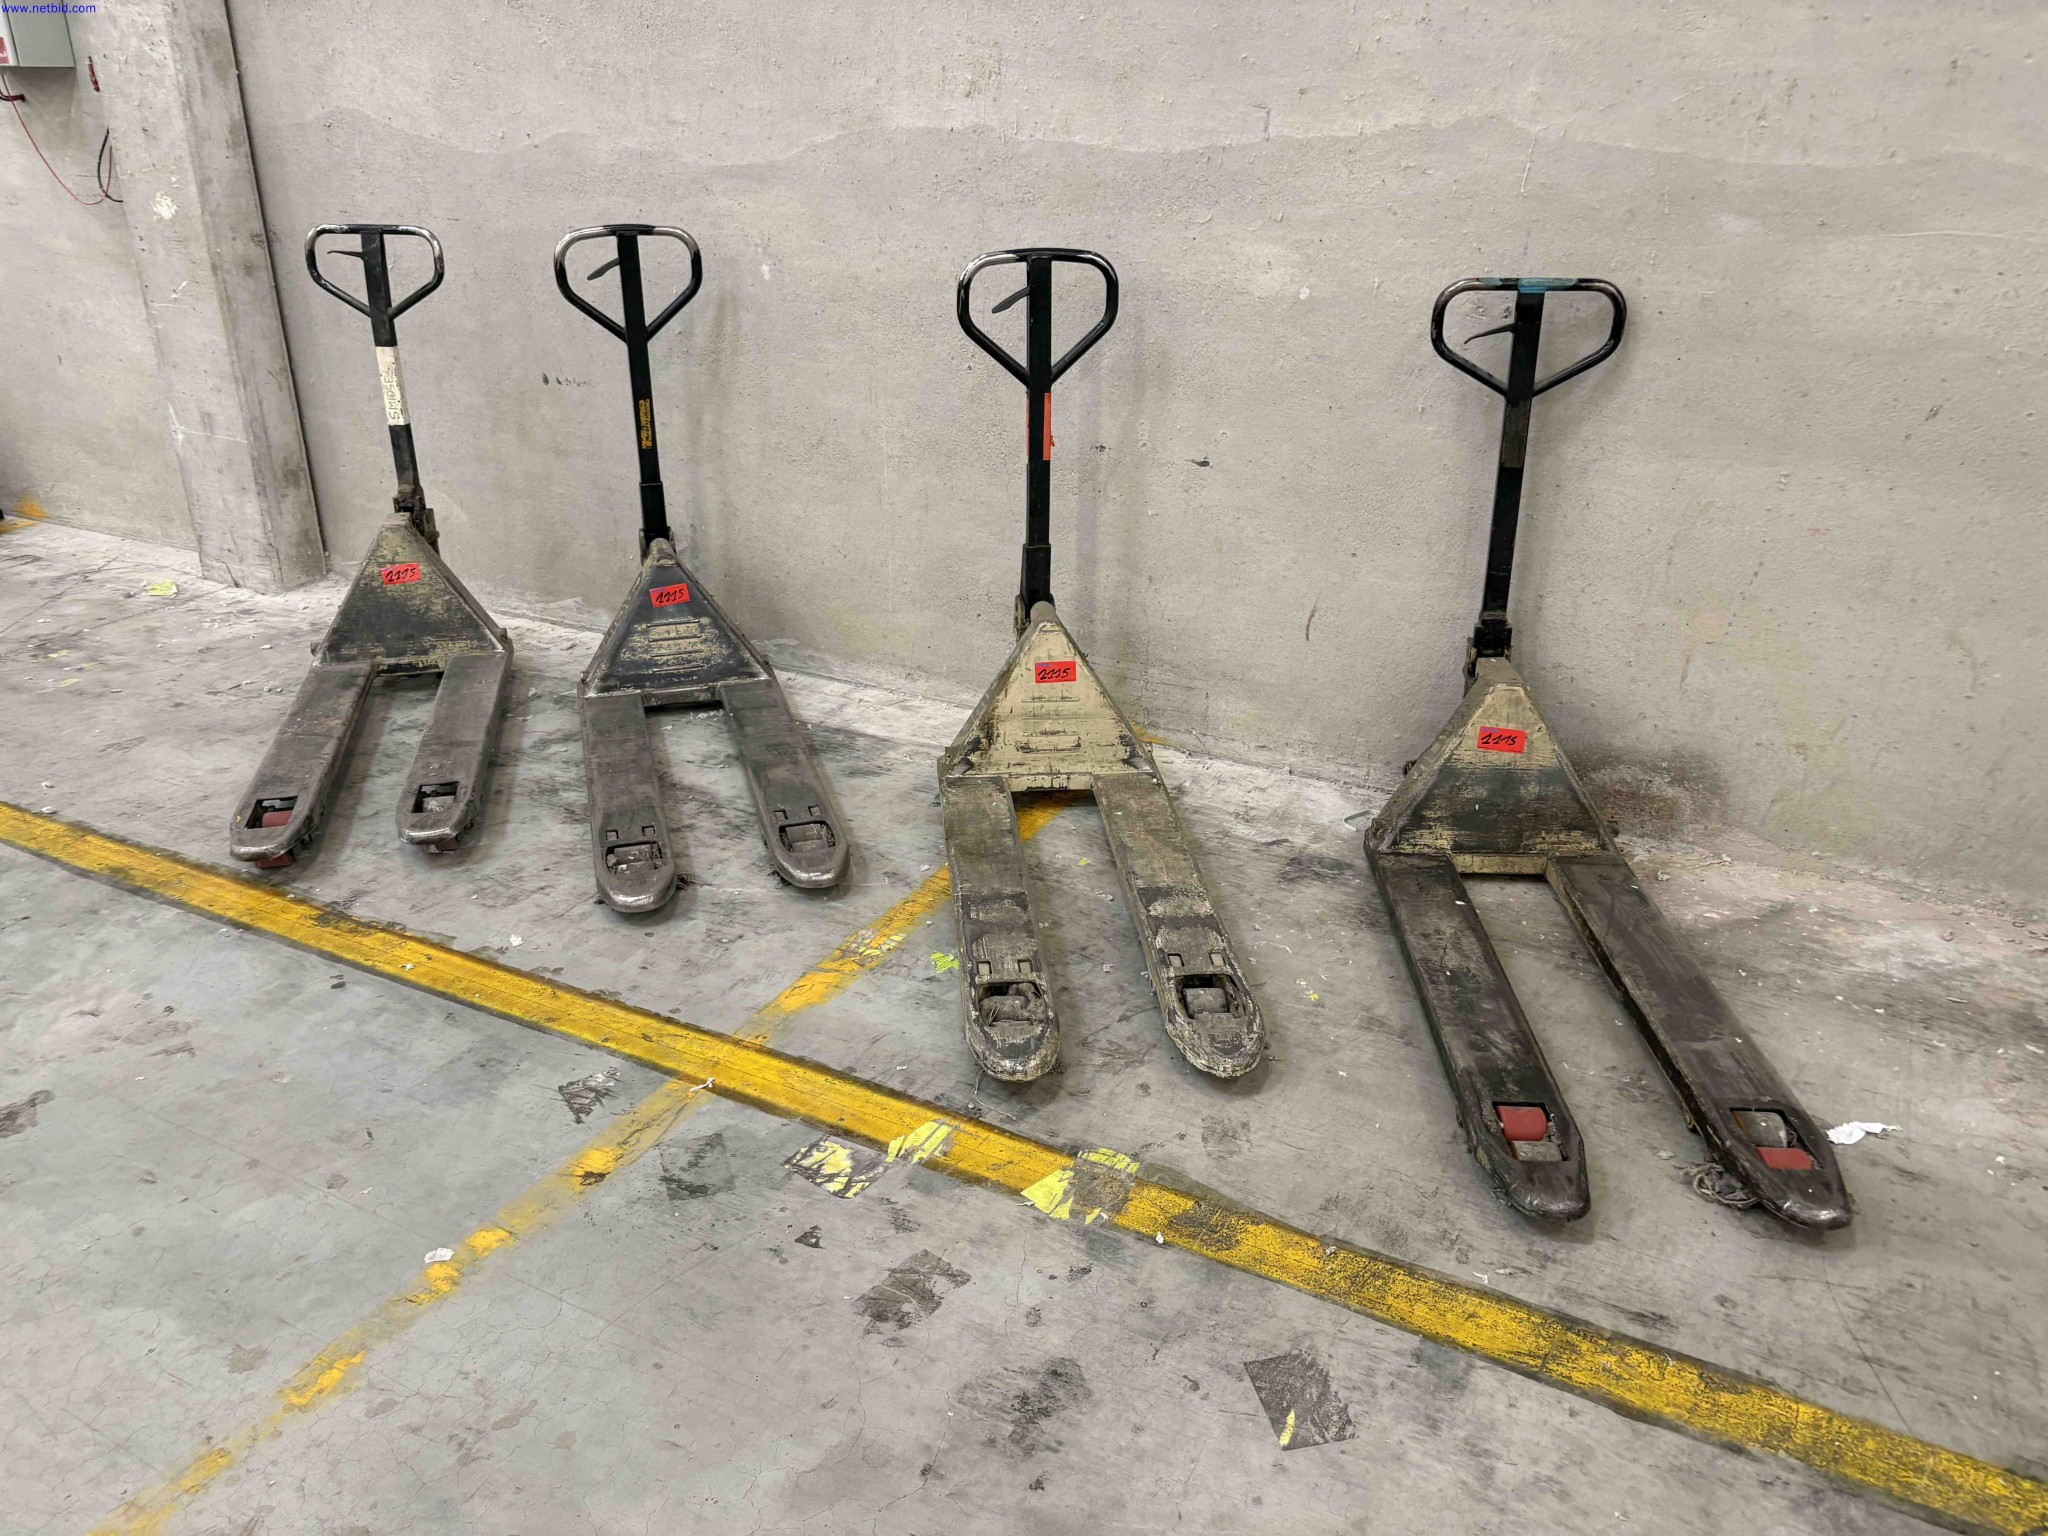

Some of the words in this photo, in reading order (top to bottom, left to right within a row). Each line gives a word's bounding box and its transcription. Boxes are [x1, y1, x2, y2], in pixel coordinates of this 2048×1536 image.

[386, 568, 416, 582] 1115
[656, 588, 683, 603] 1115
[1038, 668, 1071, 680] 1115
[1481, 733, 1518, 746] 1115
